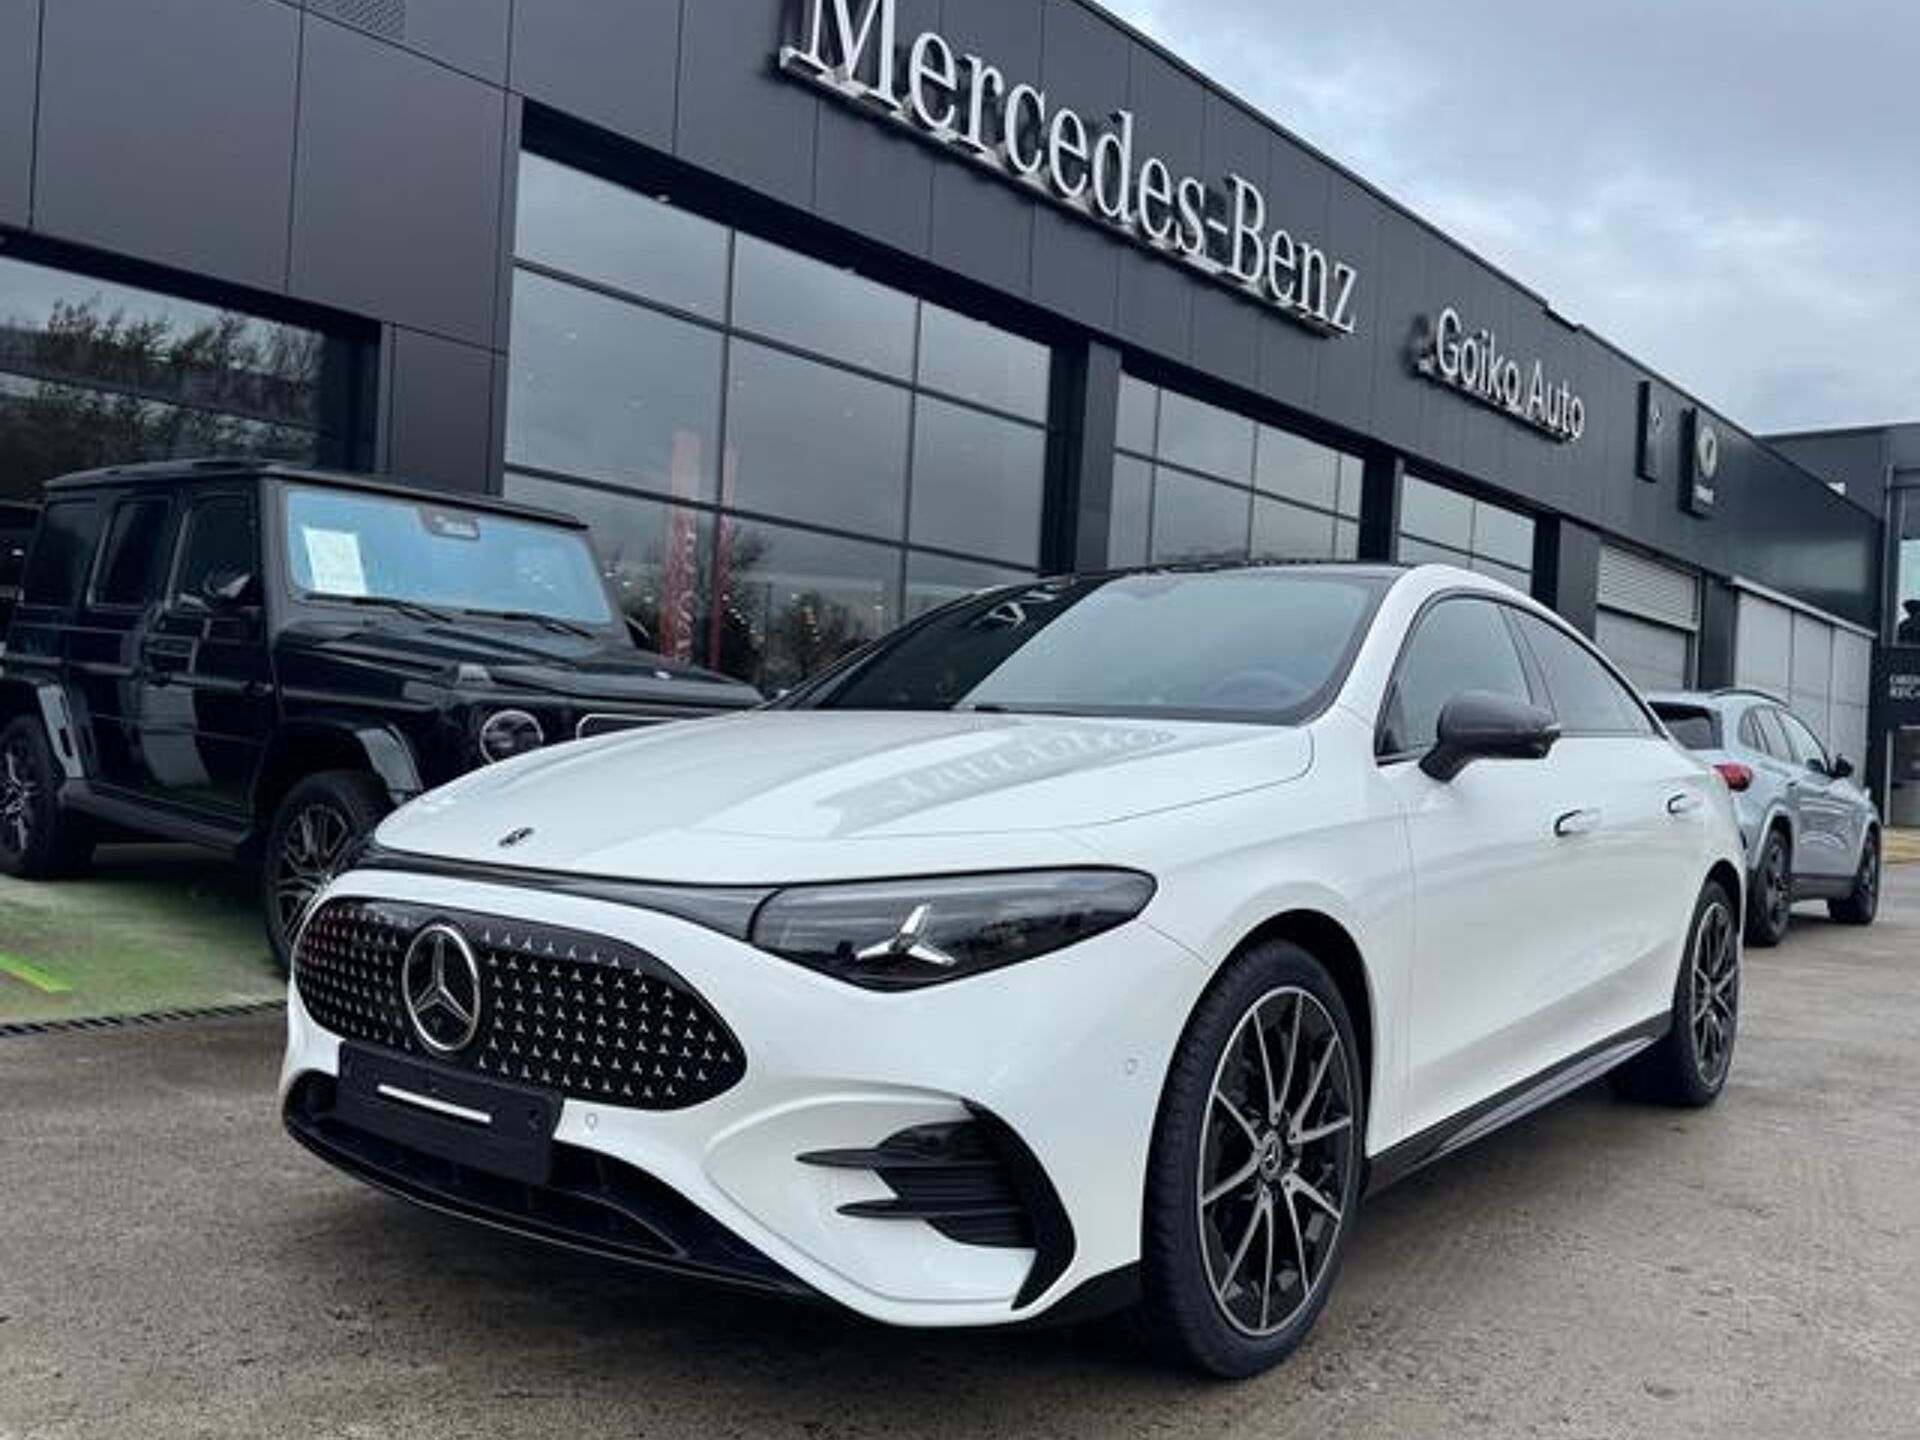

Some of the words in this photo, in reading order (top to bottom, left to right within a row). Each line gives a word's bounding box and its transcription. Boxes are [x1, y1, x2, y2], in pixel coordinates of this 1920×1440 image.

[781, 0, 1357, 333] Mercedes-Benz
[1436, 307, 1520, 406] Goiko
[1526, 360, 1585, 439] Auto
